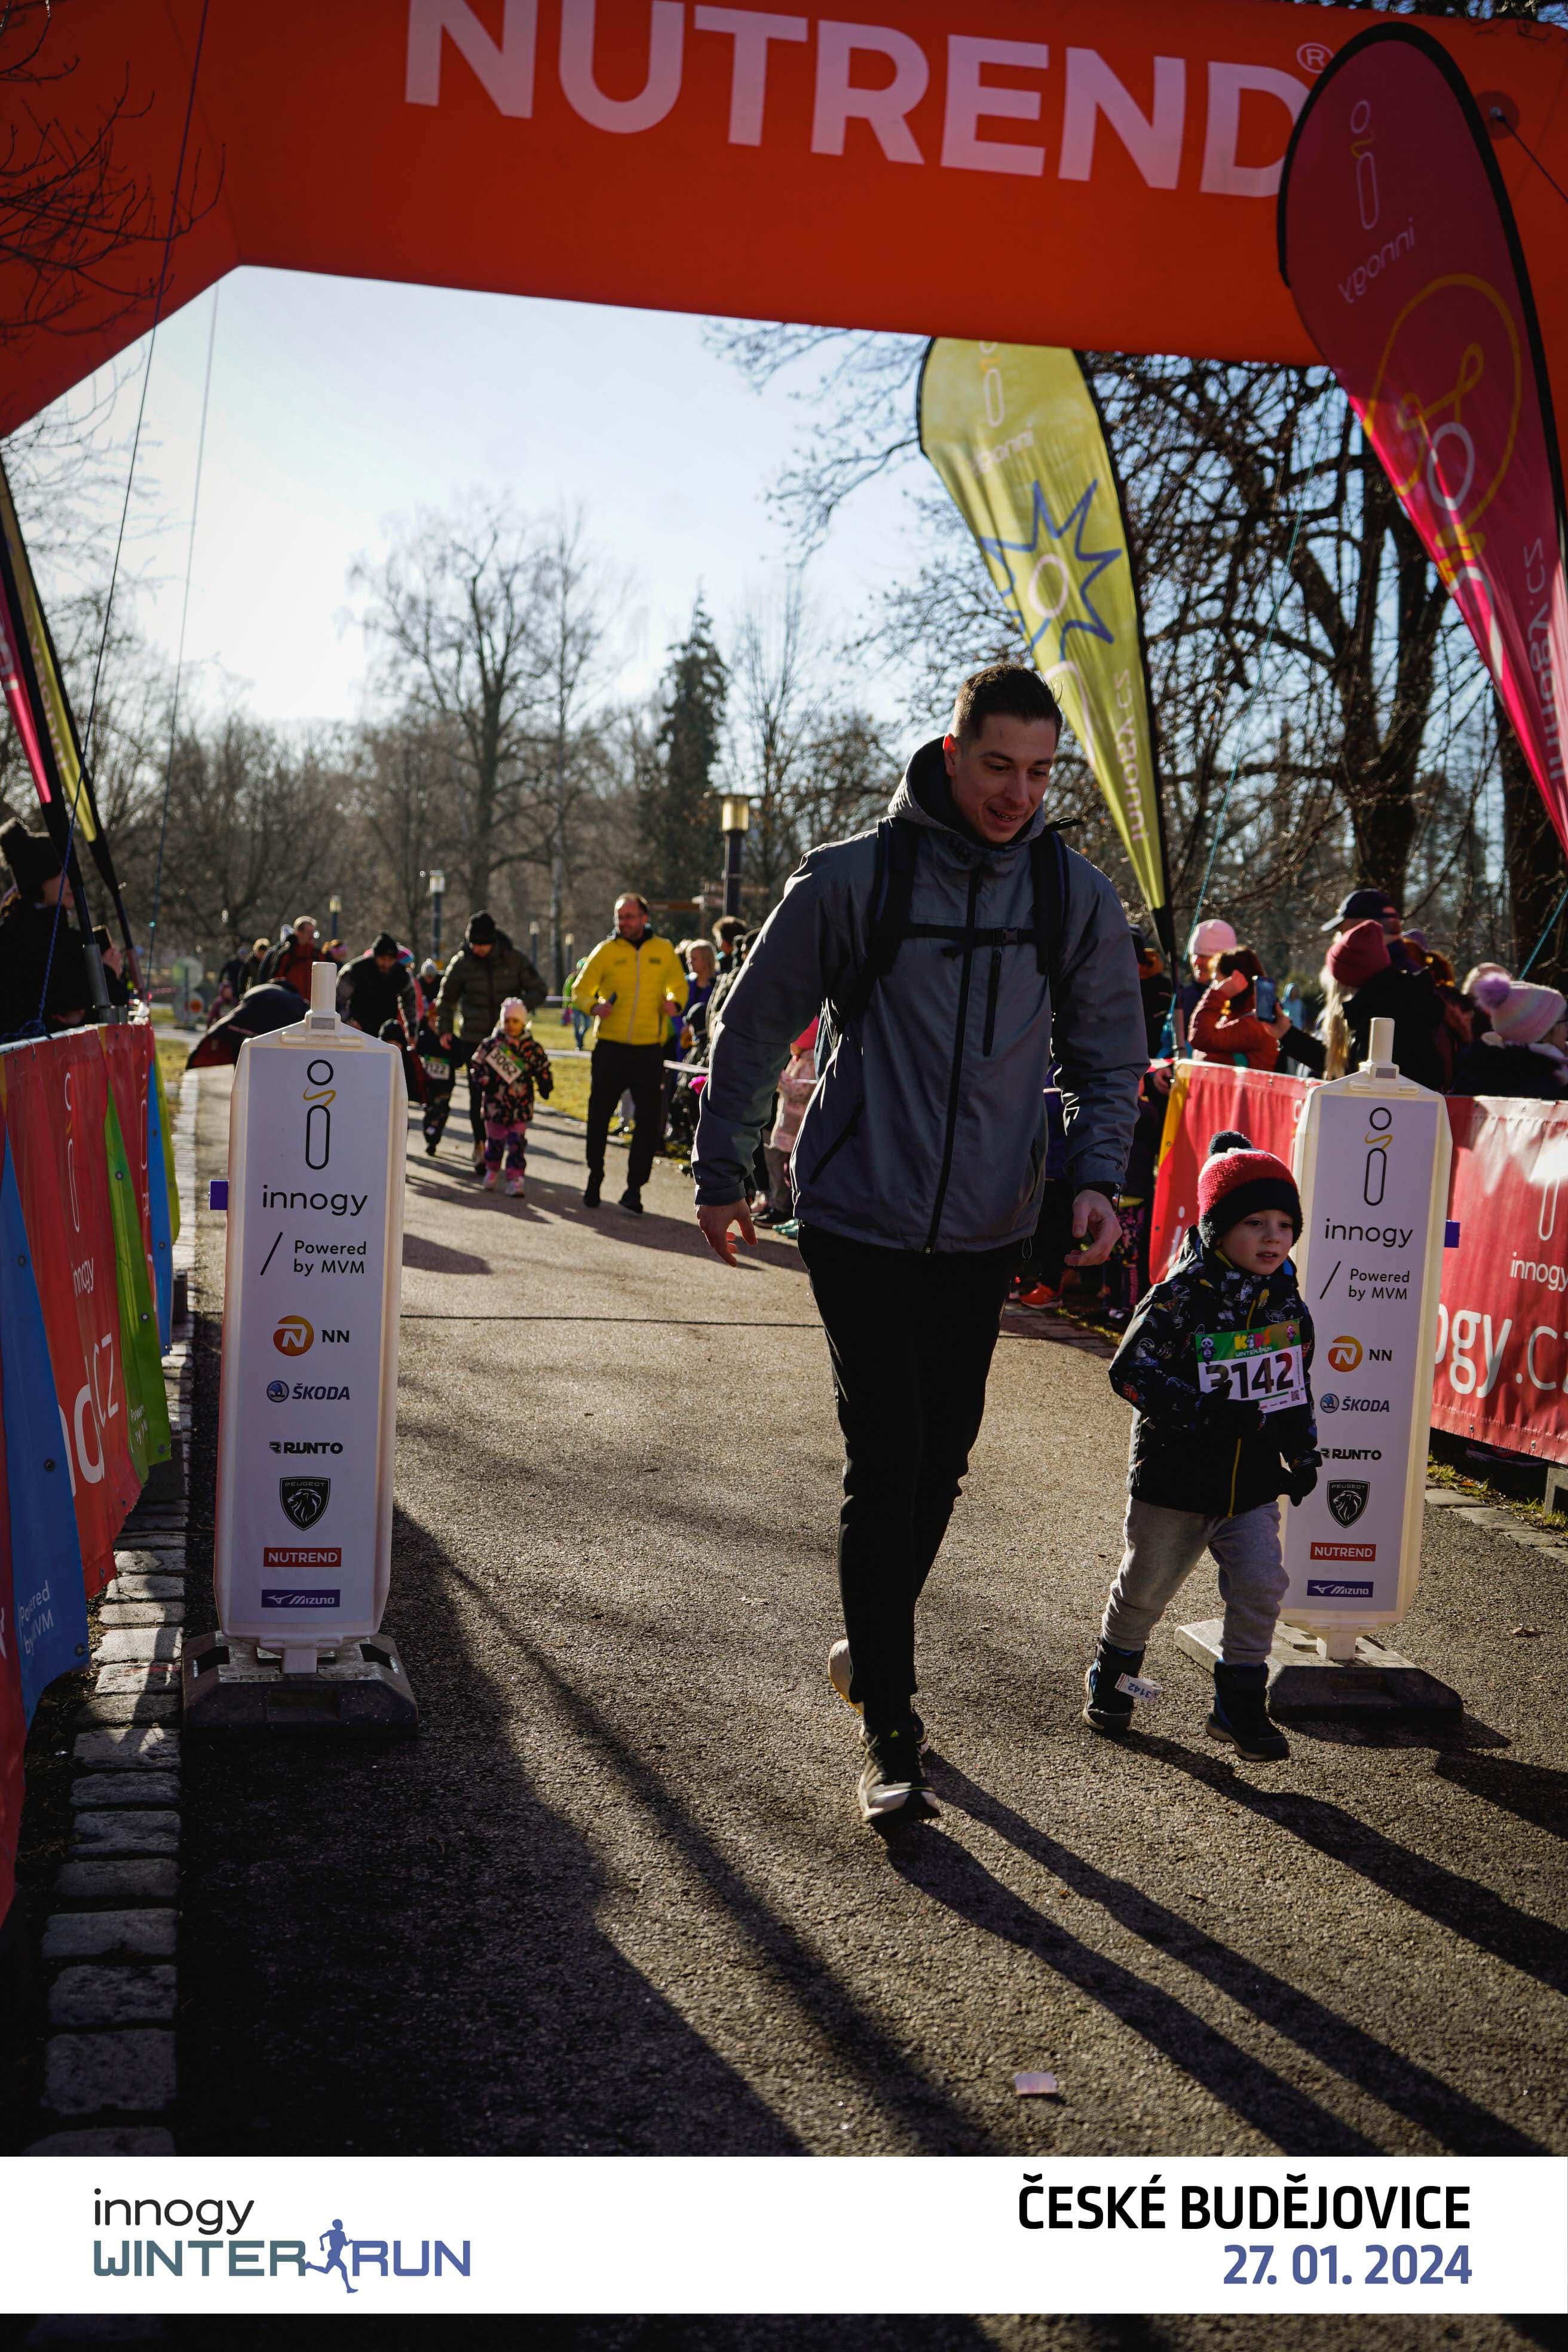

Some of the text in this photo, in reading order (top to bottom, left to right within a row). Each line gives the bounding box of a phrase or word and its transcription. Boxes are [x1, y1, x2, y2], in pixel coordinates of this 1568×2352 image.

[262, 1185, 368, 1216] innogy
[1325, 1218, 1414, 1248] innogy
[295, 1240, 367, 1255] Powered
[293, 1259, 365, 1277] by MVM
[1350, 1268, 1410, 1283] Powered
[1510, 1251, 1568, 1292] innogy
[1348, 1285, 1408, 1301] by MVM
[321, 1330, 350, 1343] NN
[1369, 1349, 1392, 1361] NN
[1205, 1353, 1294, 1399] 3142
[292, 1383, 350, 1400] ŠKODA
[1341, 1396, 1390, 1413] ŠKODA
[283, 1442, 343, 1454] RUNTO
[1332, 1448, 1382, 1460] RUNTO
[268, 1552, 338, 1563] NUTREND
[1314, 1546, 1373, 1557] NUTREND
[1128, 1682, 1152, 1698] 3142
